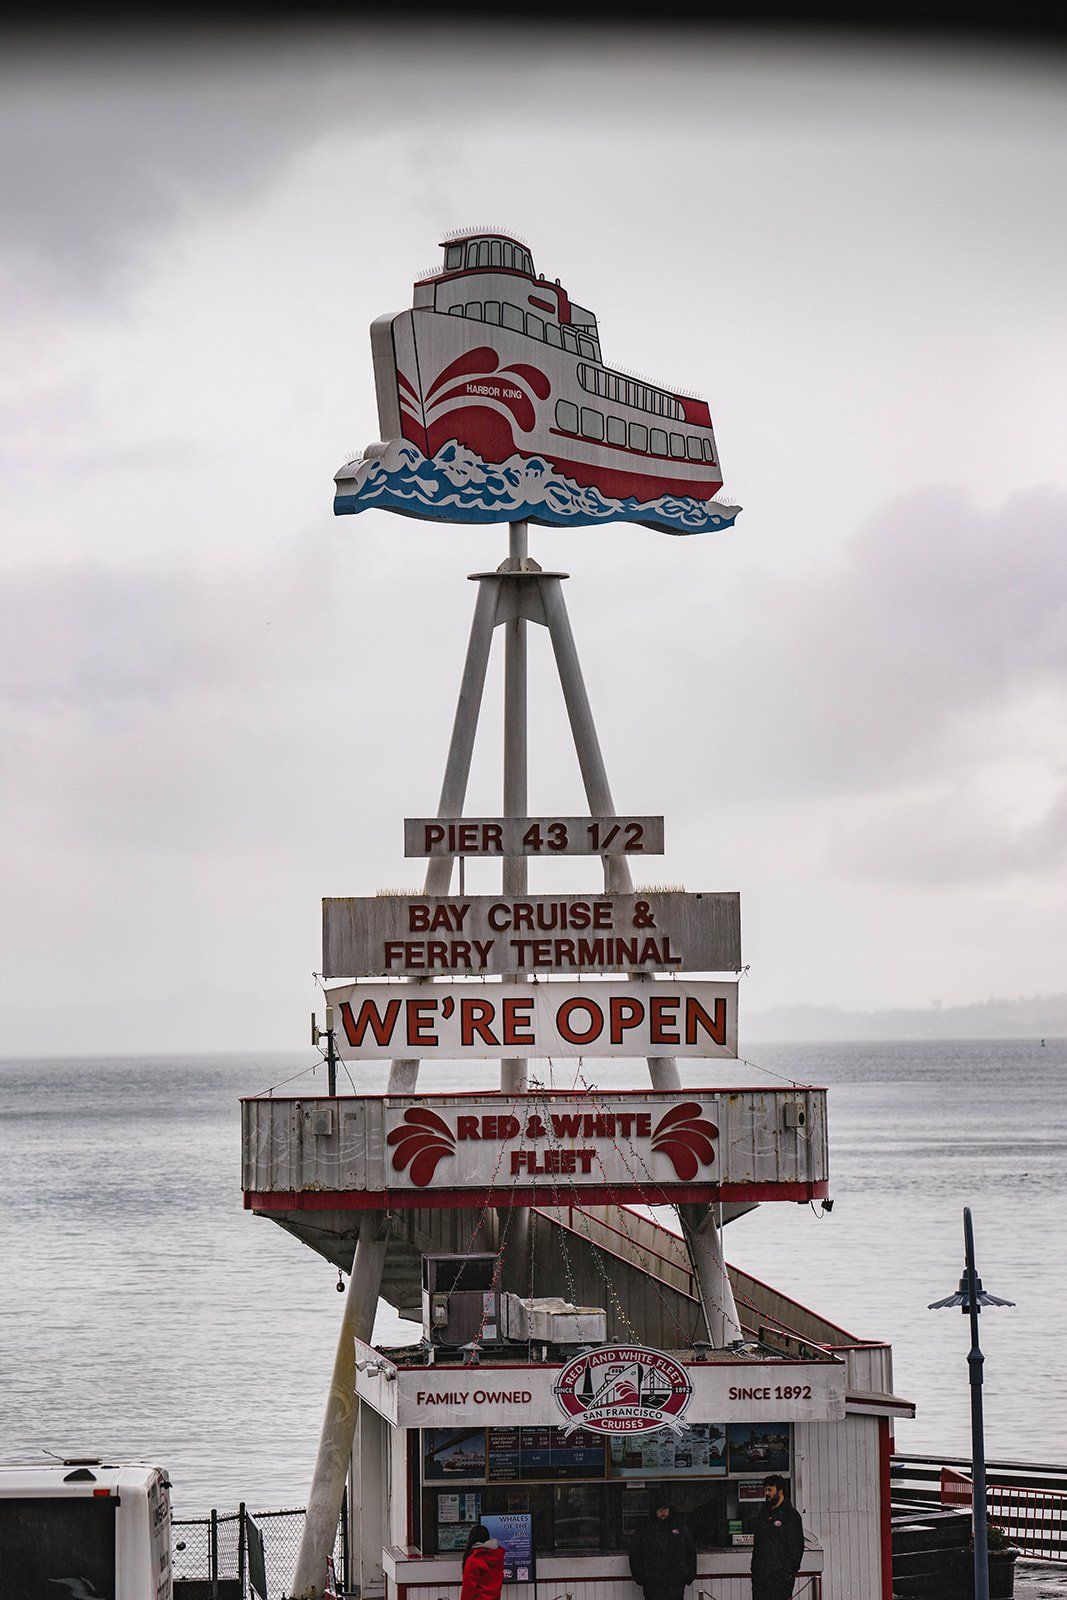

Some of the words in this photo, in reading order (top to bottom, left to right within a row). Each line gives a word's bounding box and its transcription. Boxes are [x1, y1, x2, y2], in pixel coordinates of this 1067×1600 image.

[466, 384, 500, 397] HARBOR
[502, 388, 522, 399] KING
[424, 823, 504, 853] PIER
[522, 822, 569, 851] 43
[587, 822, 644, 850] 1/2
[408, 903, 471, 932] BAY
[487, 901, 613, 931] CRUISE
[632, 900, 657, 929] &
[384, 939, 495, 969] FERRY
[510, 936, 682, 967] TERMINAL
[338, 995, 536, 1047] WE'RE
[555, 995, 728, 1046] OPEN
[456, 1114, 520, 1141] RED
[525, 1113, 548, 1139] &
[549, 1112, 652, 1139] WHITE
[510, 1149, 597, 1175] FLEET
[565, 1365, 584, 1385] RED
[591, 1352, 616, 1366] AND
[618, 1351, 654, 1364] WHITE
[655, 1359, 683, 1385] FLEET
[416, 1391, 470, 1405] FAMILY
[473, 1390, 532, 1404] OWNED
[728, 1386, 771, 1400] SINCE
[774, 1385, 812, 1400] 1892
[583, 1408, 603, 1421] SAN
[606, 1407, 663, 1420] FRANCISCO
[601, 1419, 644, 1429] CRUISES
